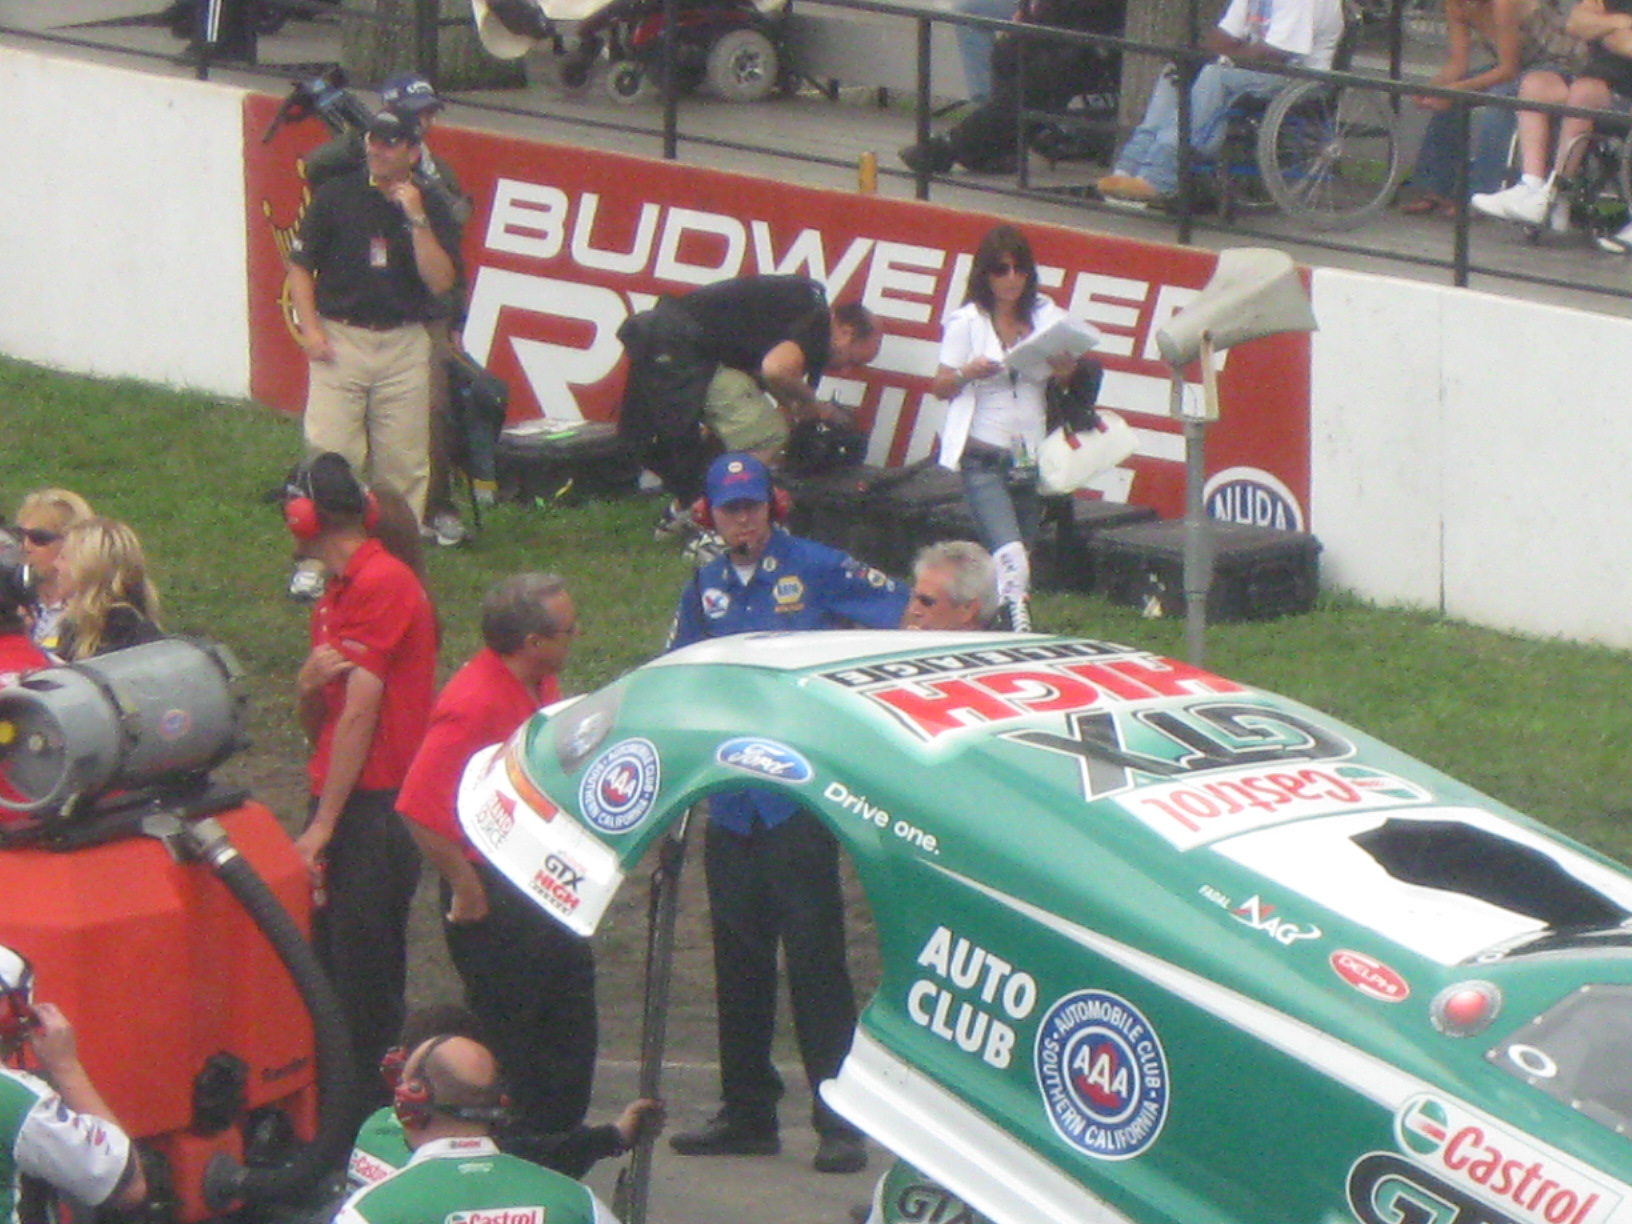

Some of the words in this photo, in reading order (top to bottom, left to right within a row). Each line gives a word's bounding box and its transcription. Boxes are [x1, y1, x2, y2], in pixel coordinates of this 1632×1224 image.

[484, 177, 1230, 372] BUDWEIER
[868, 655, 1250, 738] HIGH
[605, 766, 637, 798] AAA
[995, 701, 1358, 801] GTX
[824, 780, 889, 829] Drive
[893, 818, 942, 856] one.
[1141, 768, 1364, 833] Castrol
[534, 869, 581, 910] HIGH
[543, 853, 585, 892] GTX
[916, 925, 1037, 1020] AUTO
[1337, 953, 1398, 995] DELPHI
[907, 978, 1016, 1070] CLUB
[1055, 1000, 1144, 1044] AUTOMOBILE
[1136, 1040, 1162, 1090] CLUB
[1041, 1035, 1088, 1137] SOUTHERN
[1083, 1100, 1160, 1150] CALIFORNIA
[1072, 1043, 1130, 1099] AAA
